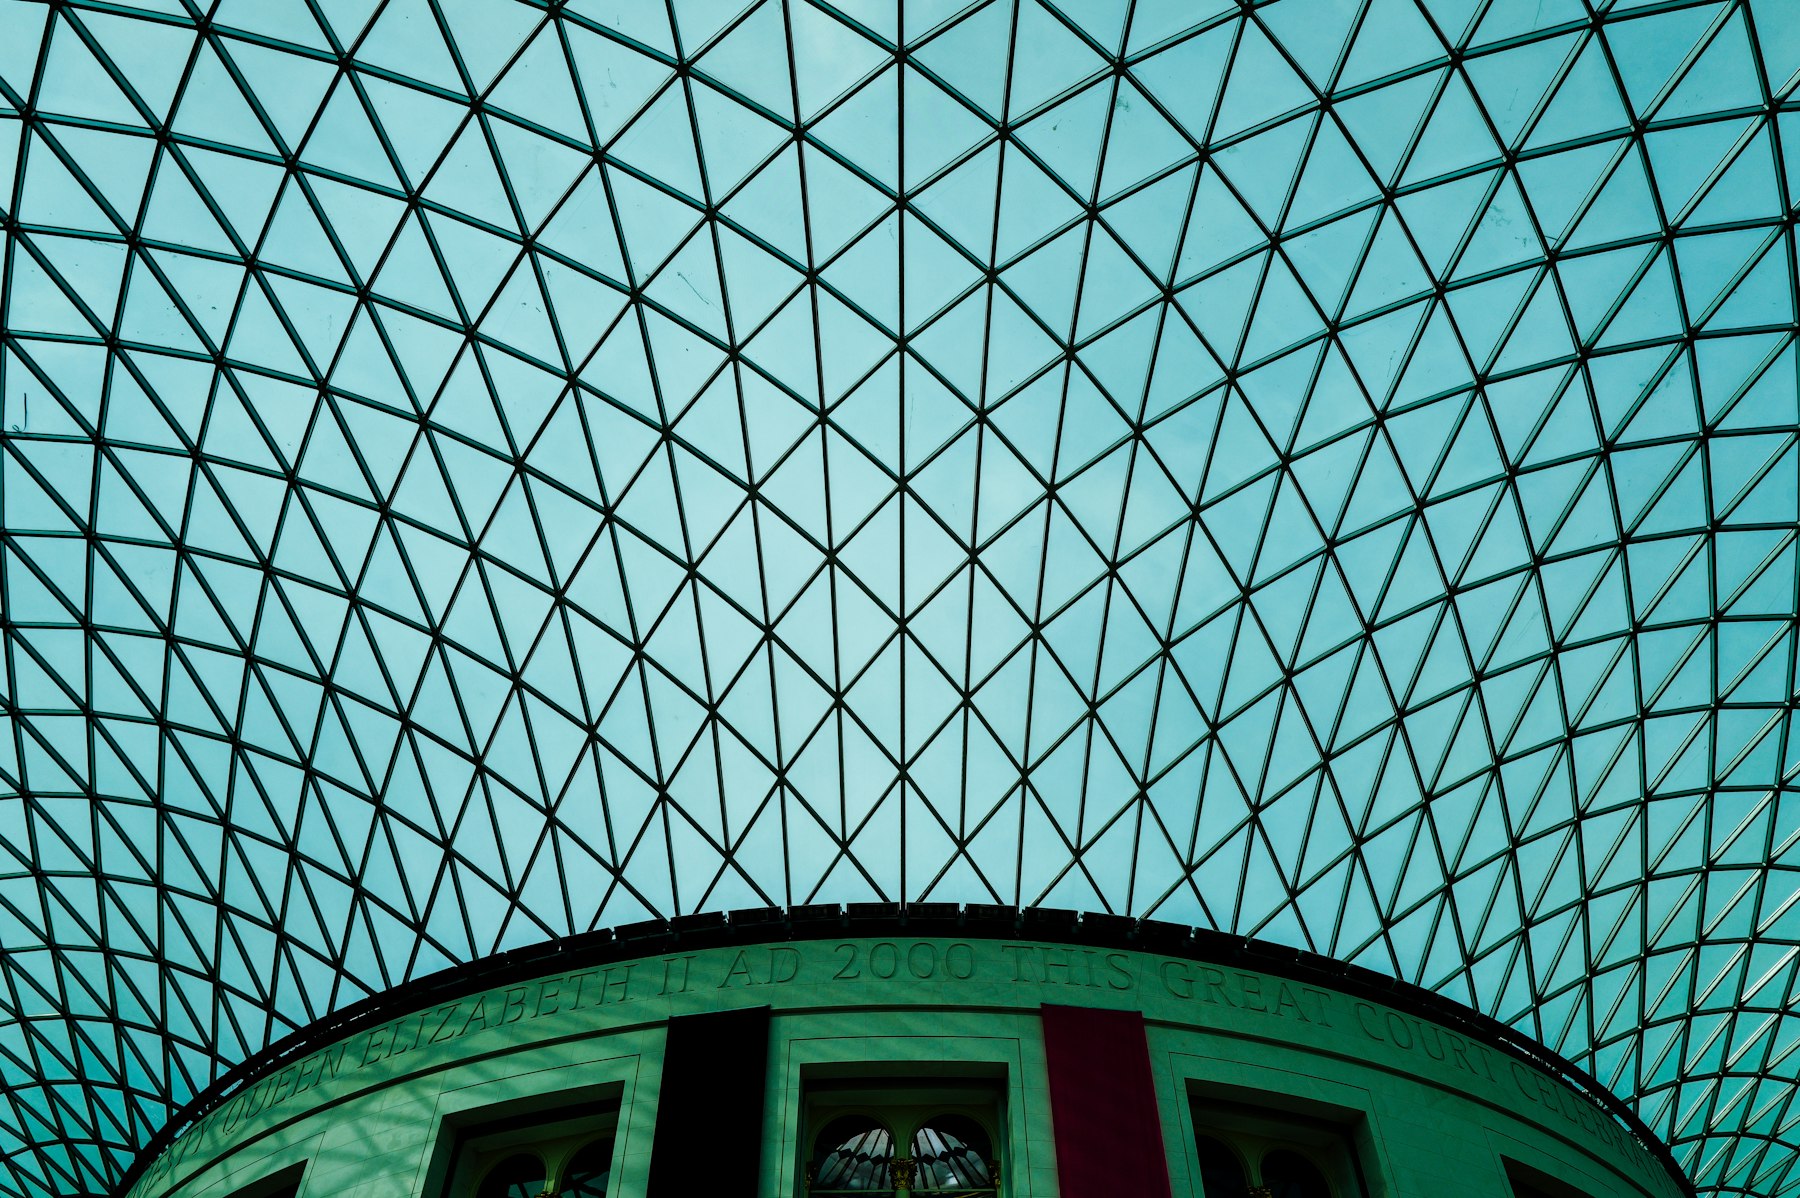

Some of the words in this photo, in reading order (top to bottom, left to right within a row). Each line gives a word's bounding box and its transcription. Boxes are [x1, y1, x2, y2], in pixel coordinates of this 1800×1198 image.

[222, 1041, 351, 1135] QUEEN
[357, 963, 640, 1069] ELIZABETH
[656, 955, 698, 997] II
[716, 946, 804, 989] AD
[831, 941, 978, 982] 2000
[1000, 945, 1135, 992] THIS
[1158, 960, 1335, 1028] GREAT
[1353, 1001, 1497, 1084] COURT
